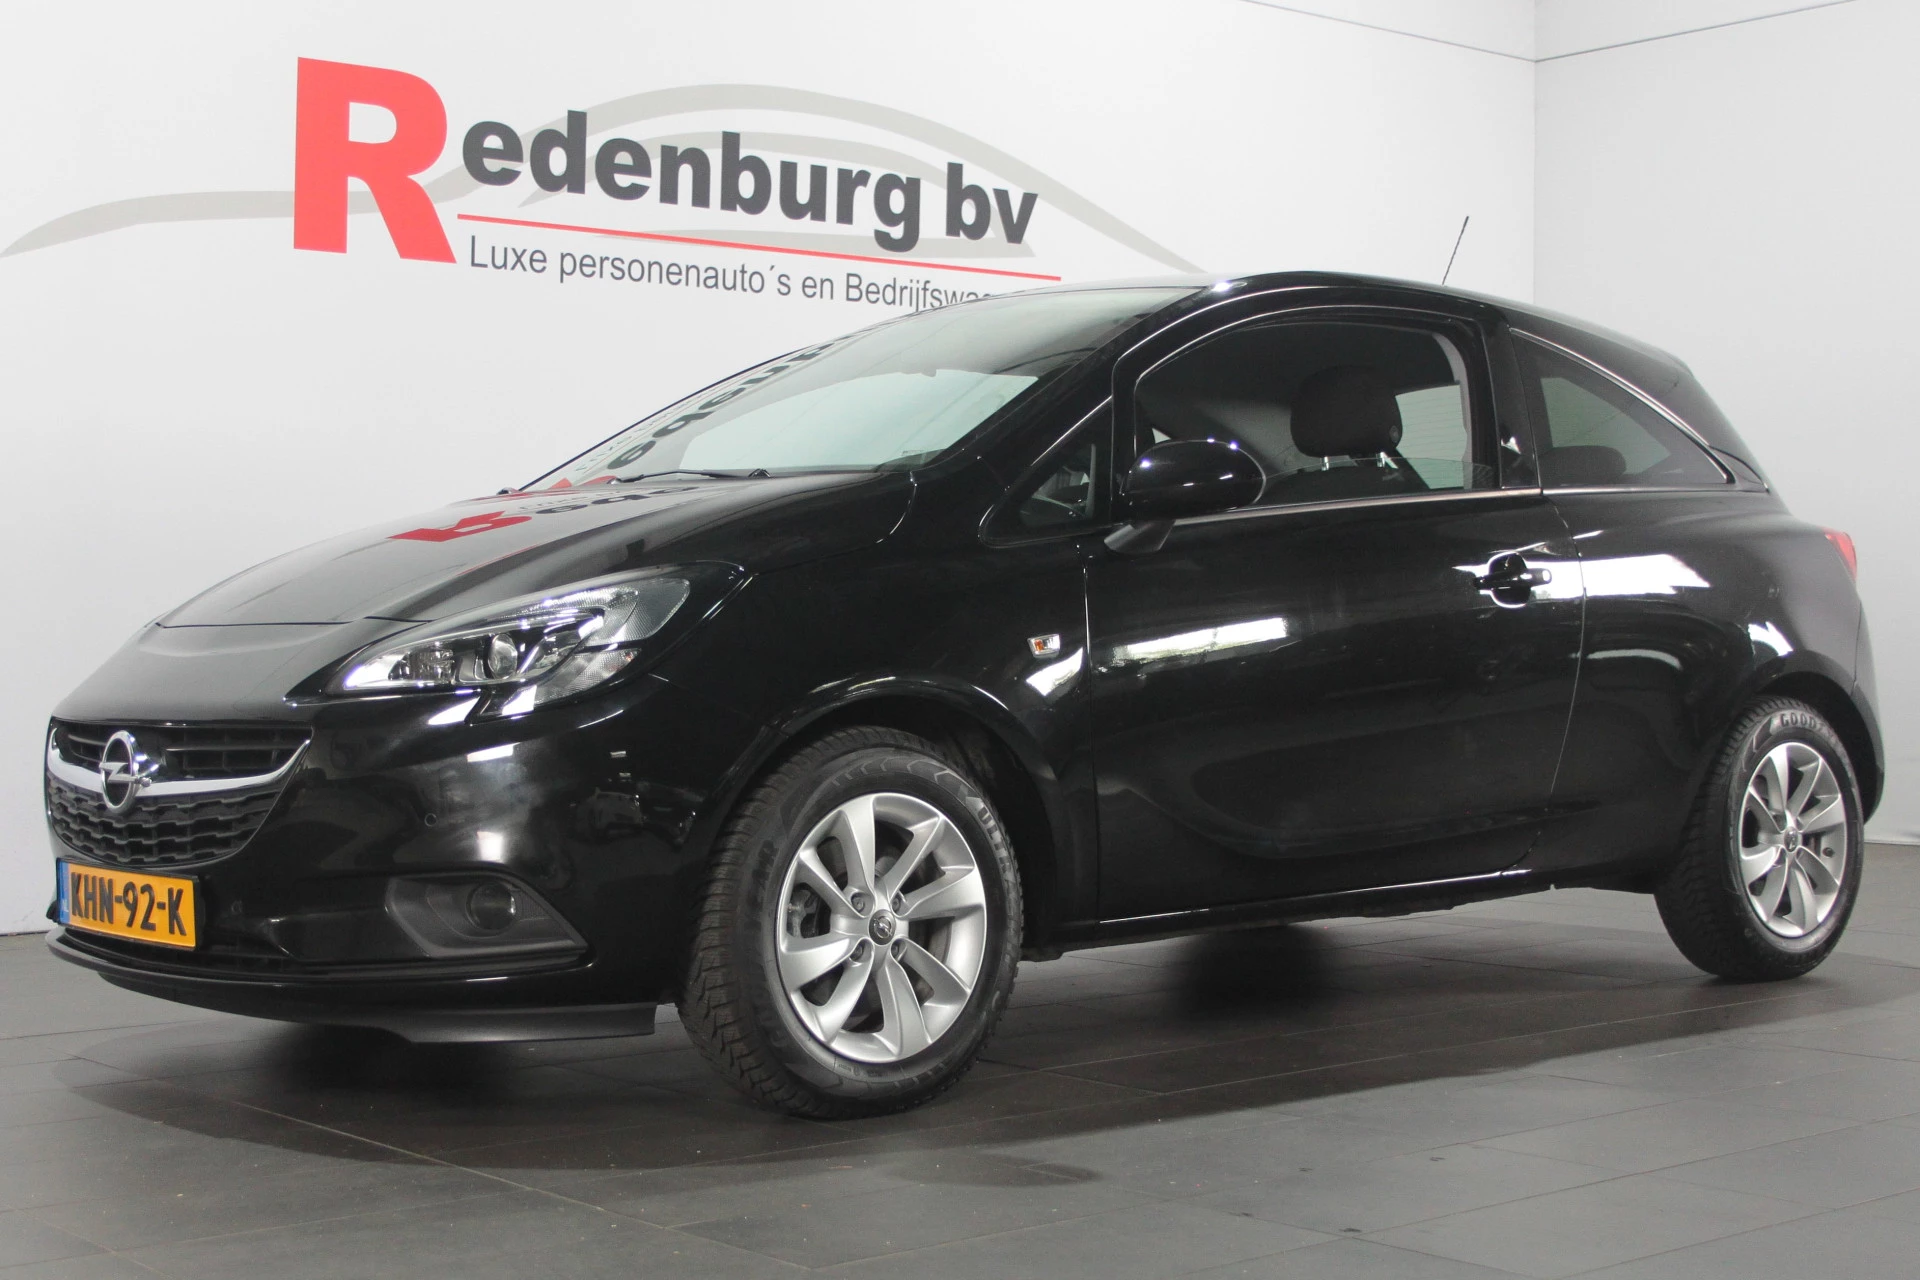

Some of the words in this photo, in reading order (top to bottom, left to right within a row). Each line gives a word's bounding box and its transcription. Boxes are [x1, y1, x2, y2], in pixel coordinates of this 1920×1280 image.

[294, 57, 921, 263] Redenburg
[945, 162, 1038, 245] bv
[470, 235, 547, 274] Luxe
[801, 274, 834, 300] en
[845, 272, 991, 312] Bedrijfsw
[70, 871, 188, 937] KHN-92-K
